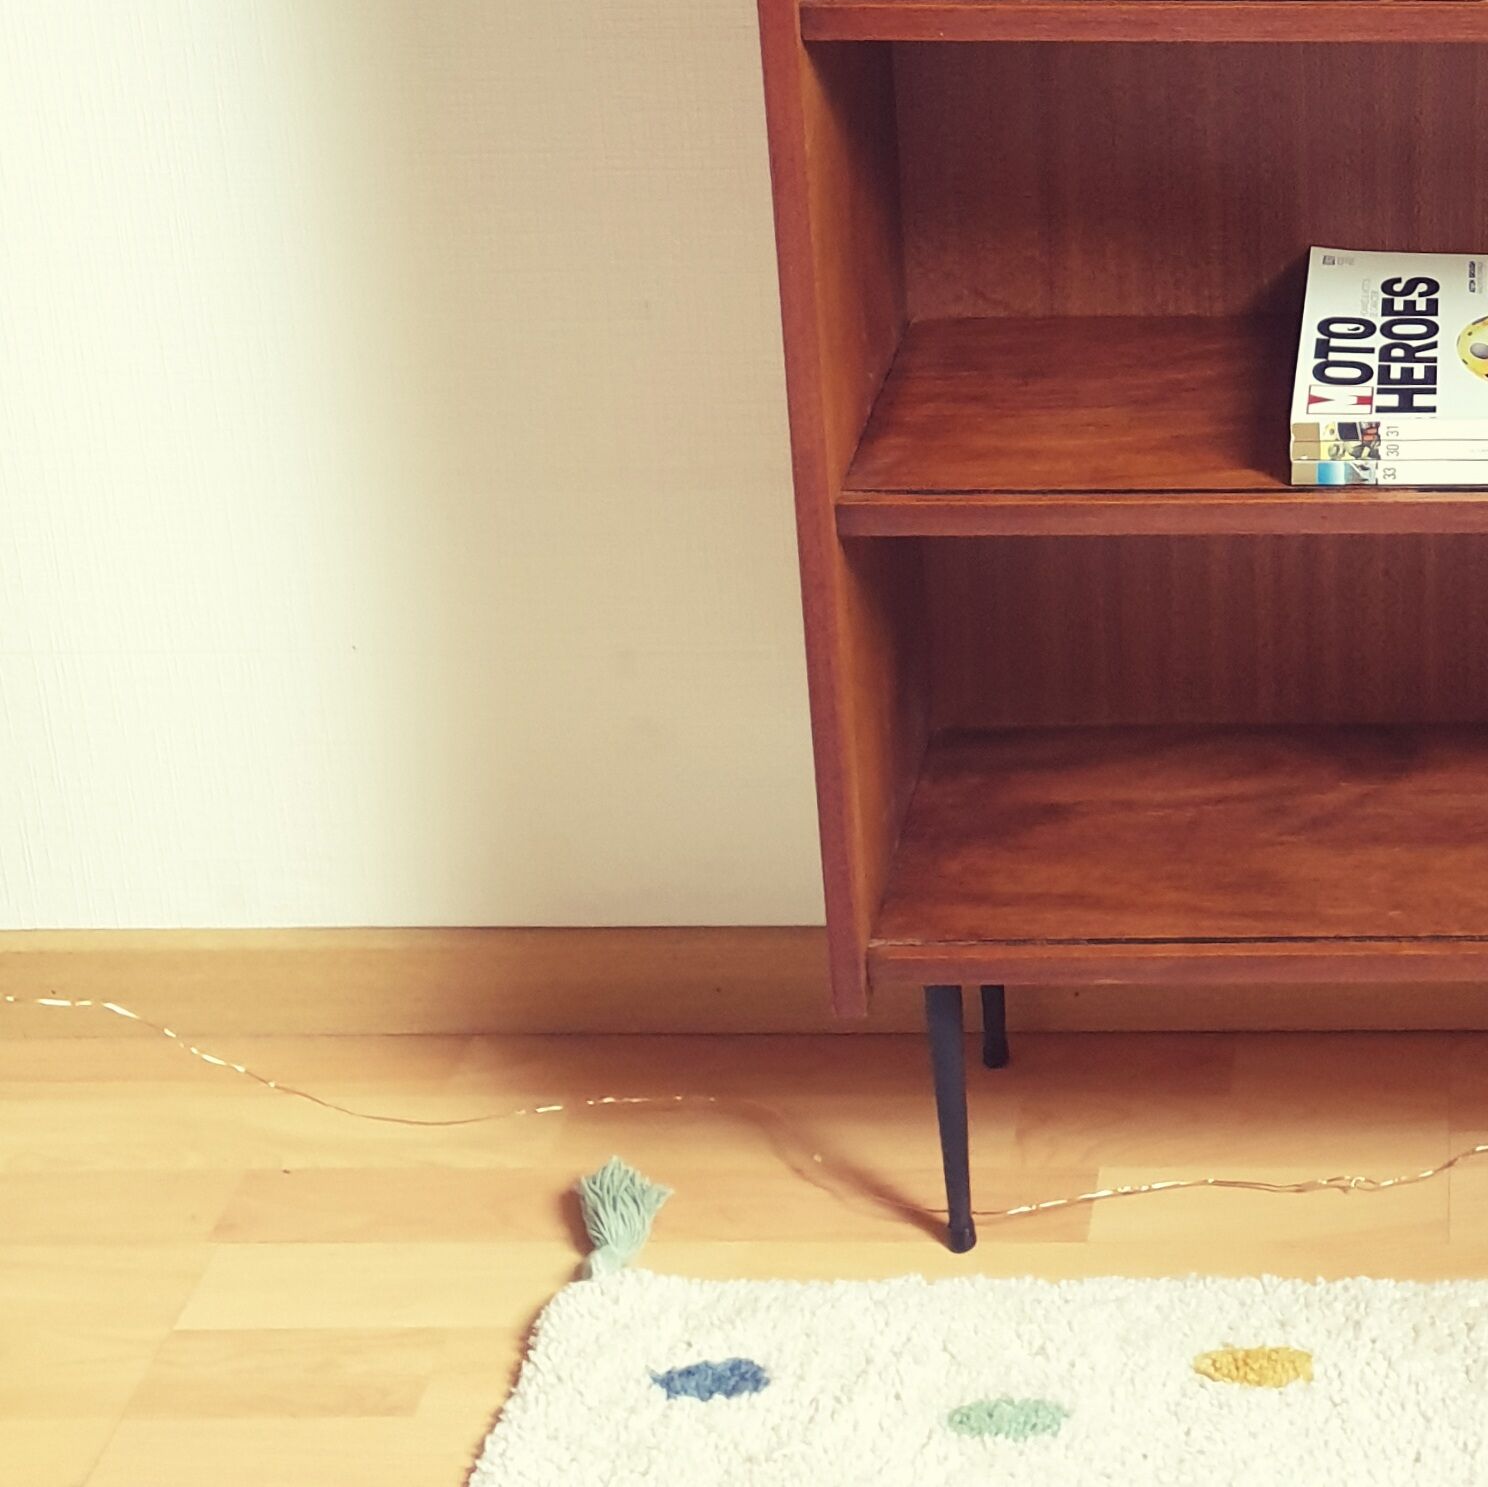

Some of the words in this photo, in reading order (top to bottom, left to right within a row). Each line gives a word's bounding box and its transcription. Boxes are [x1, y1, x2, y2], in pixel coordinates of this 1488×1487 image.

[1375, 277, 1440, 413] HEROES
[1307, 317, 1377, 414] MOTO
[1386, 425, 1400, 437] 31
[1386, 444, 1400, 457] 30
[1383, 467, 1397, 480] 33
